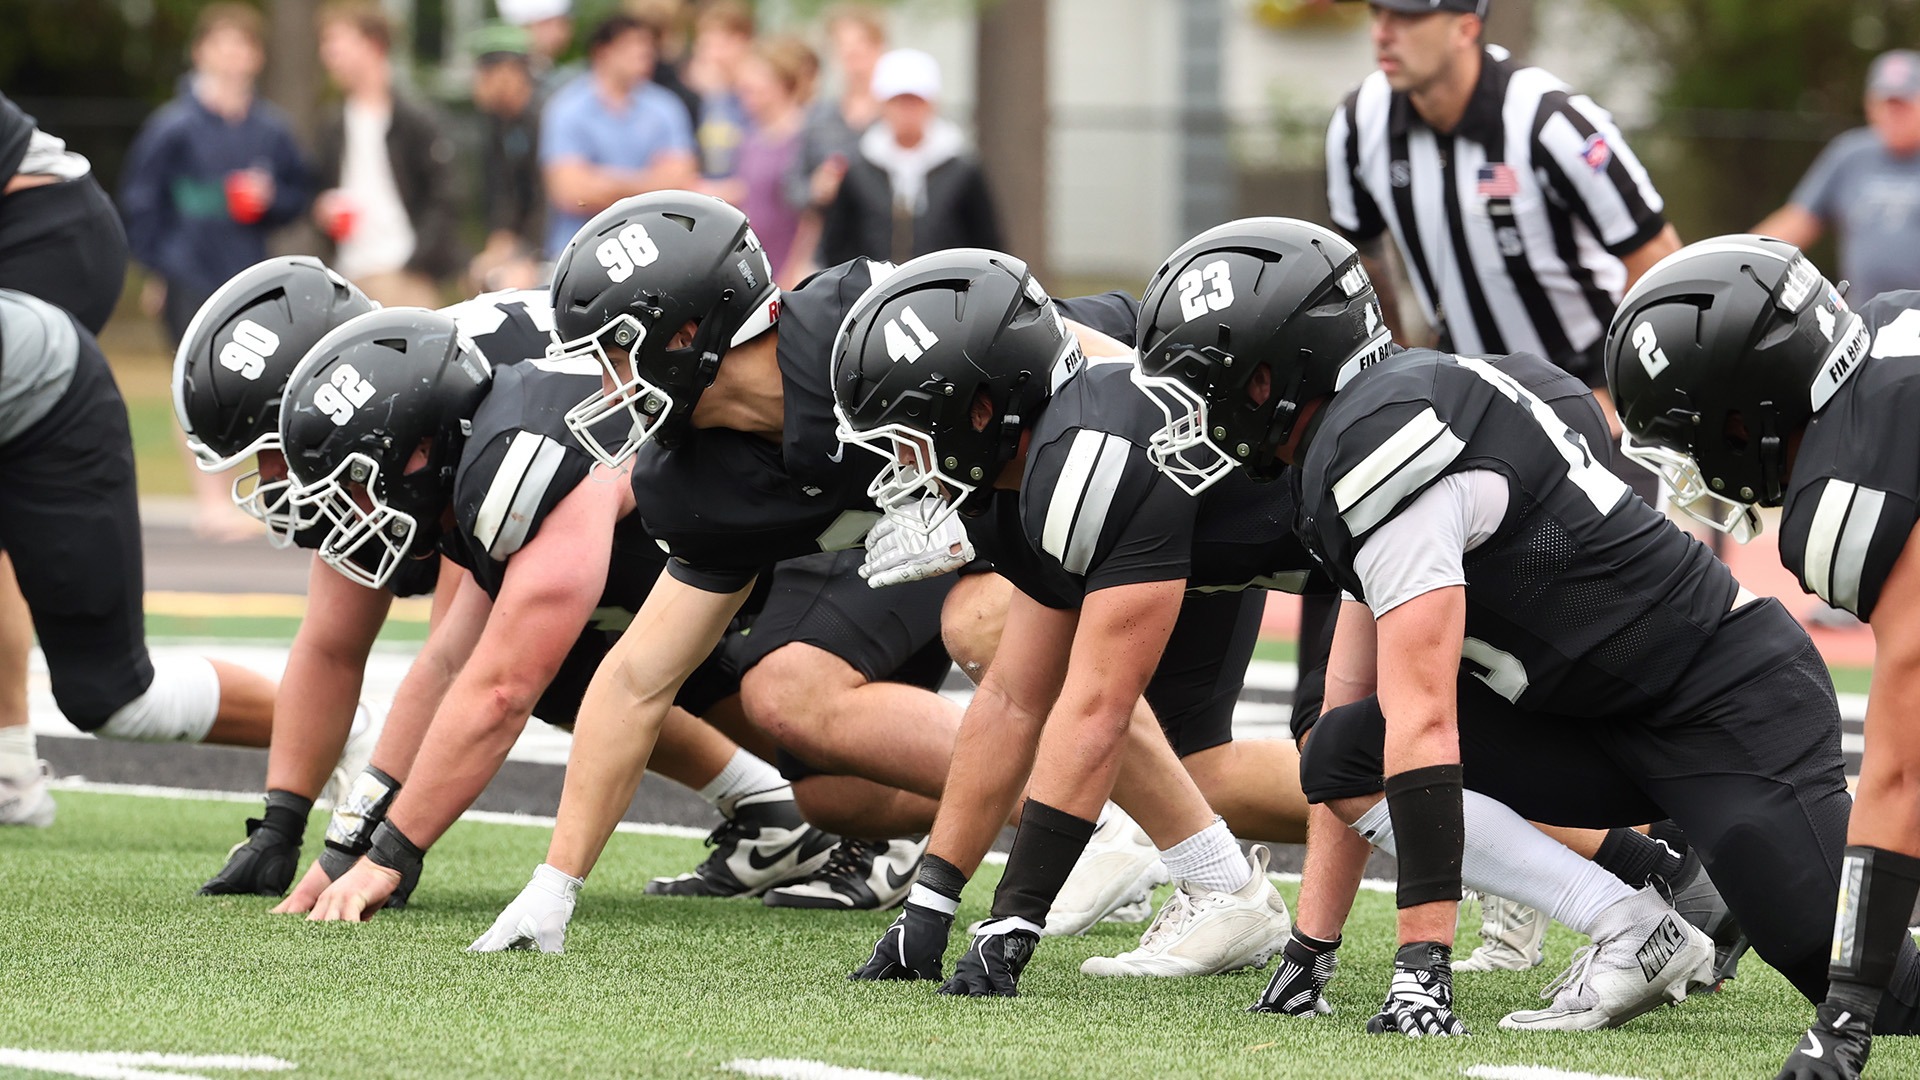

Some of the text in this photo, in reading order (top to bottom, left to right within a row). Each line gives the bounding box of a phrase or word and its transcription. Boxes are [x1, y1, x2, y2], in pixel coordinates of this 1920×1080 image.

[595, 223, 660, 284] 98
[1177, 259, 1236, 323] 23
[219, 319, 281, 381] 90
[883, 305, 940, 364] 41
[1064, 350, 1079, 375] FIX
[1359, 350, 1378, 373] FIX
[1631, 321, 1670, 380] 2
[313, 364, 377, 426] 92
[1829, 355, 1850, 385] FIX
[1635, 914, 1685, 983] NIKE
